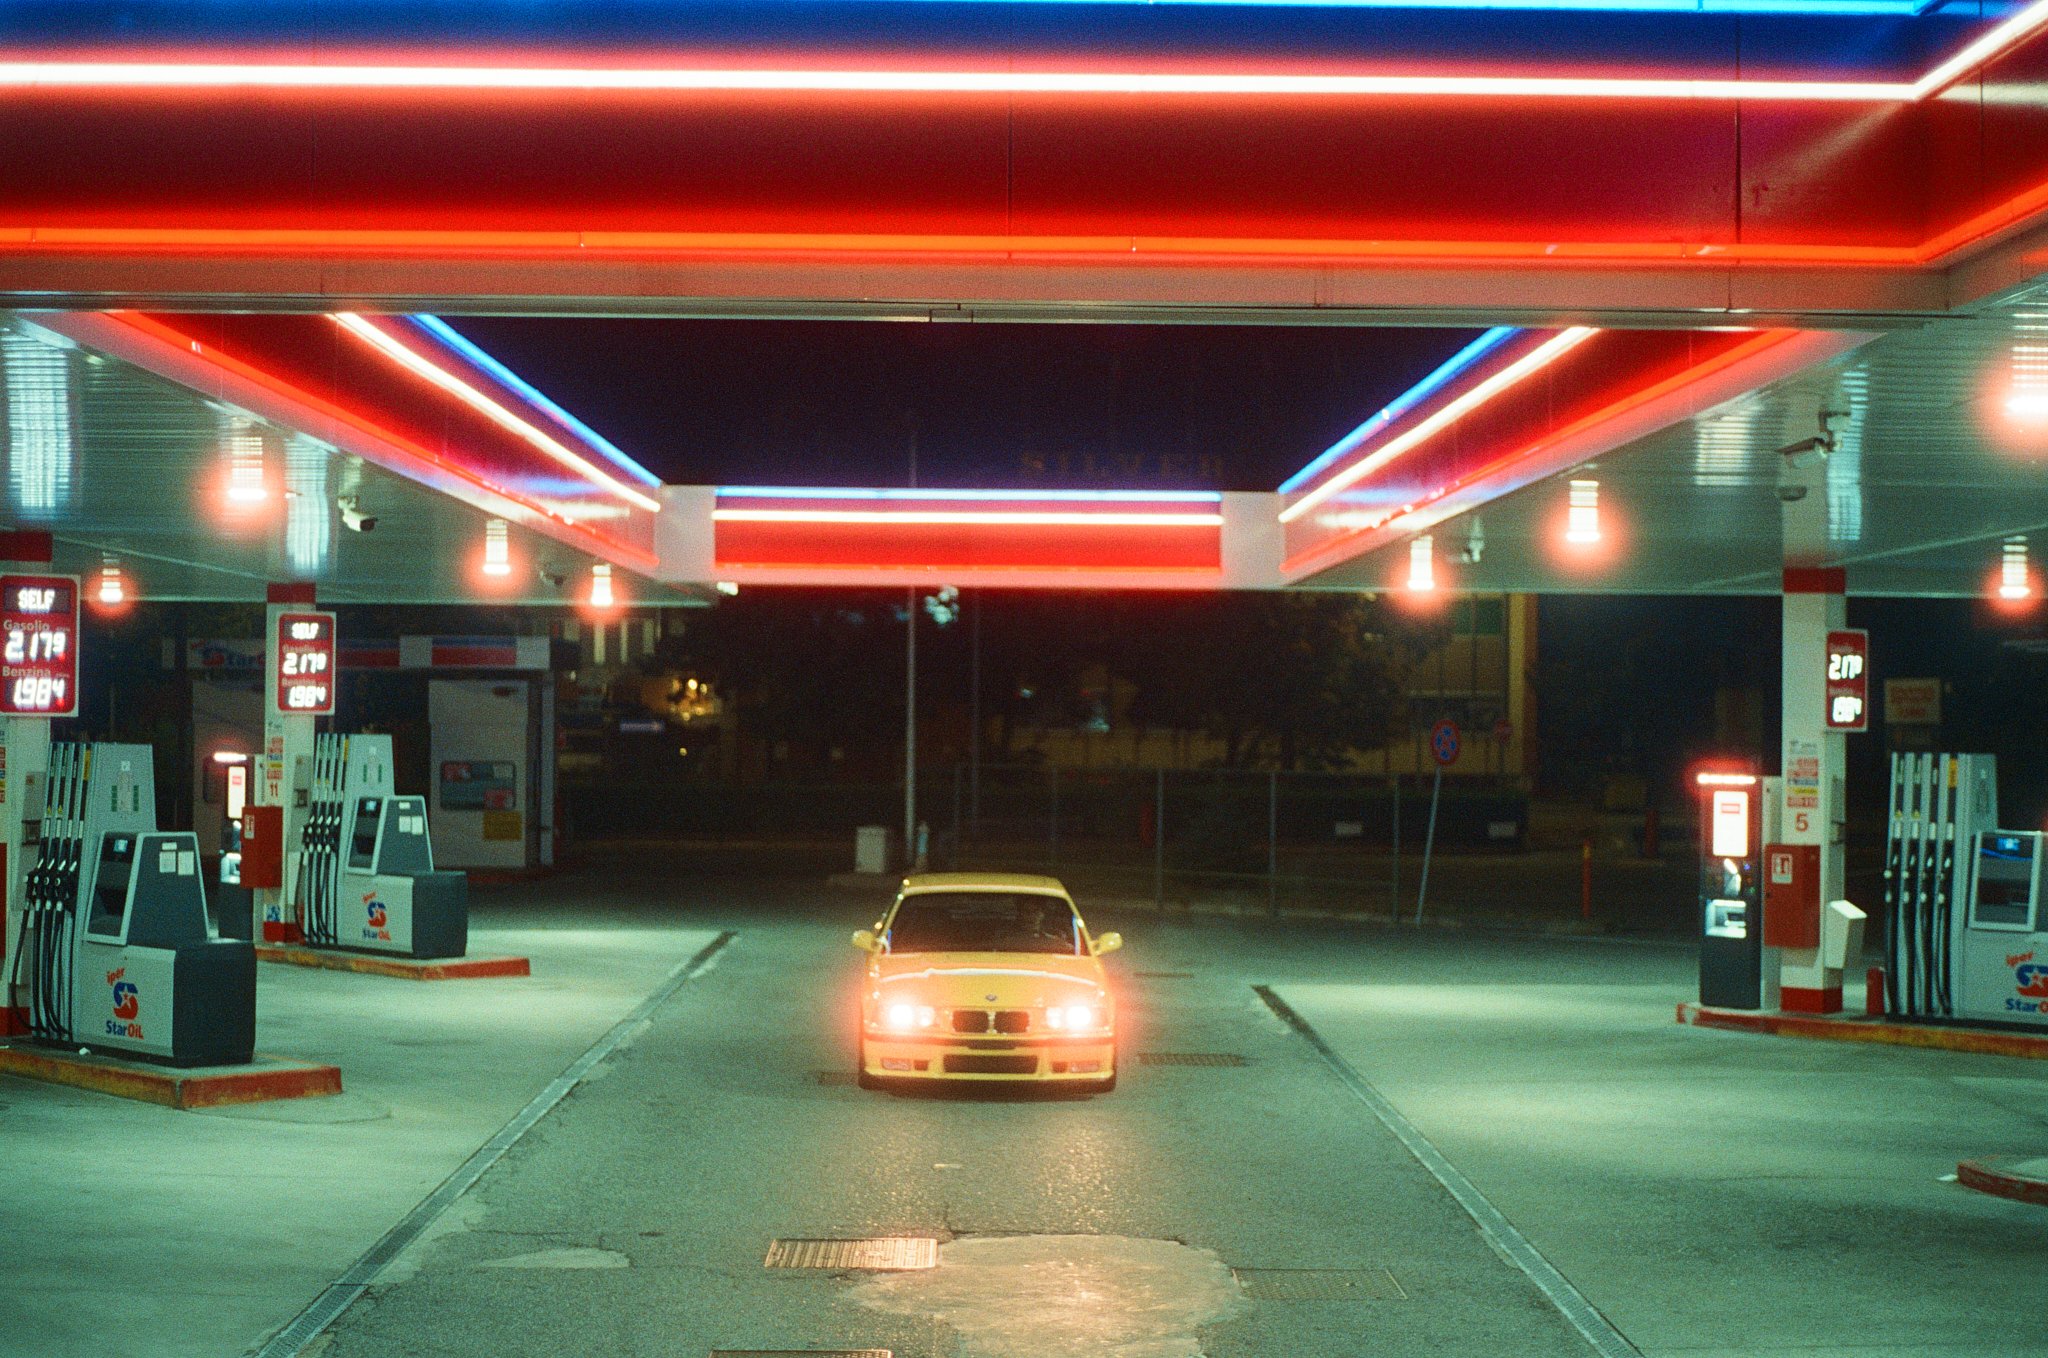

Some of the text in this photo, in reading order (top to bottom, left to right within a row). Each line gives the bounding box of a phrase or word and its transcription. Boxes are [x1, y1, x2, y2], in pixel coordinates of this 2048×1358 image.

[18, 587, 55, 613] SELF
[3, 619, 50, 632] Gasolio
[2, 666, 51, 678] Benzina
[1795, 812, 1809, 832] 5
